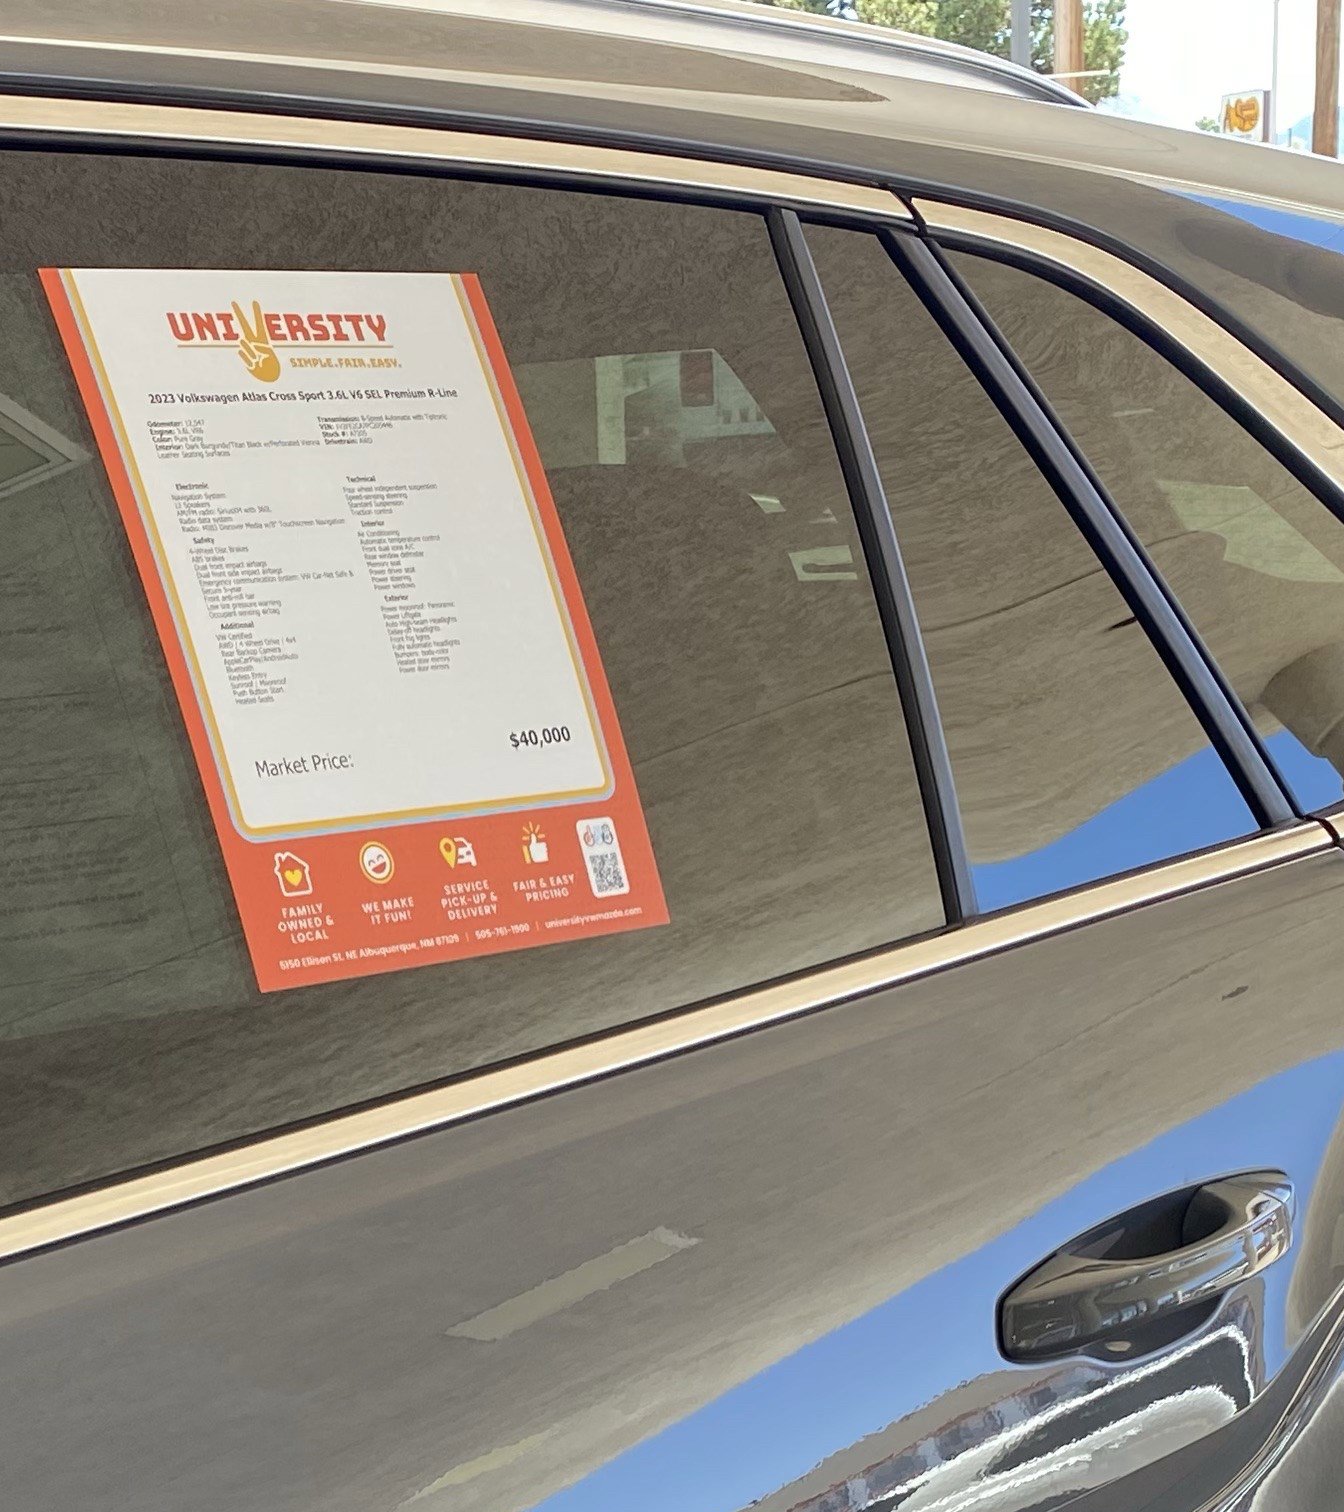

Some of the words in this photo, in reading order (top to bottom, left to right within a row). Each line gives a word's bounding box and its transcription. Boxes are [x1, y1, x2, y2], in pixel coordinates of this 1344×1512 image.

[166, 305, 388, 342] UNIVERSITY
[149, 394, 175, 404] 2023
[177, 394, 239, 404] Volkswagen
[242, 392, 267, 401] Atlas
[269, 392, 296, 401] Cross
[298, 391, 326, 402] Sport
[327, 390, 349, 400] 3.6L
[349, 390, 363, 399] V6
[364, 390, 383, 399] SEL
[384, 389, 426, 398] Premium
[427, 388, 457, 398] R-Line
[255, 758, 309, 777] Market
[312, 754, 354, 770] Price:
[510, 727, 570, 749] $40,000
[444, 880, 489, 895] SERVICE
[513, 880, 536, 891] FAIR
[539, 878, 547, 888] &
[549, 874, 574, 886] EASY
[441, 893, 486, 907] PICK-UP
[490, 891, 497, 902] &
[526, 888, 569, 901] PRICING
[282, 904, 322, 918] FAMILY
[362, 902, 379, 913] WE
[382, 897, 413, 910] MAKE
[448, 904, 496, 920] DELIVERY
[278, 917, 322, 931] OWNED
[326, 915, 334, 926] &
[371, 914, 381, 925] IT
[384, 910, 411, 922] FUN!
[291, 930, 328, 943] LOCAL
[301, 956, 331, 966] Ellison
[345, 950, 358, 959] NE
[420, 938, 435, 948] NM
